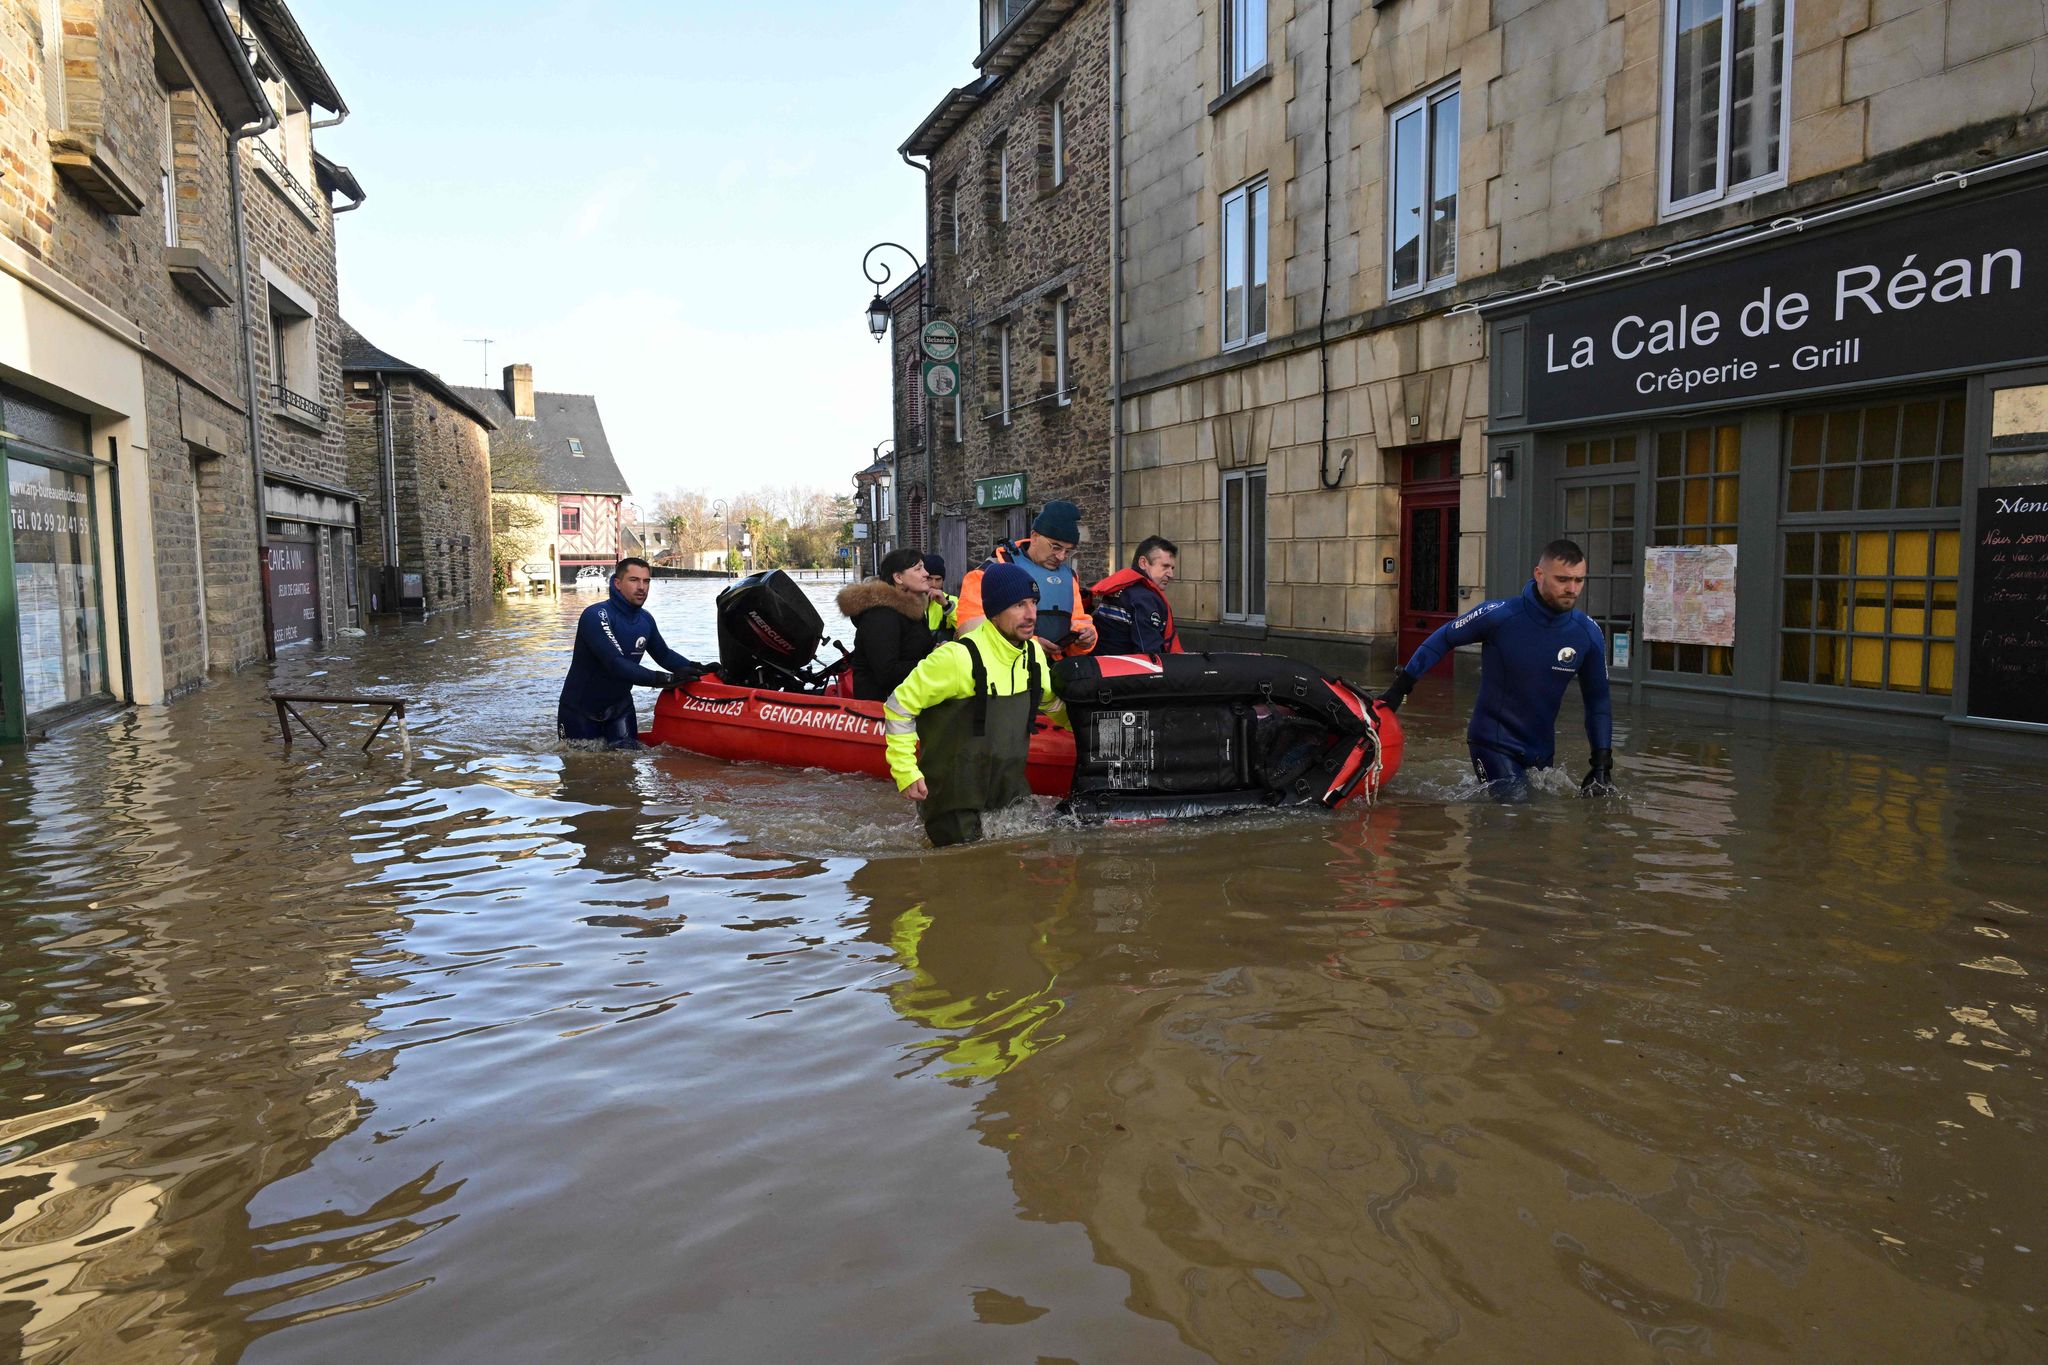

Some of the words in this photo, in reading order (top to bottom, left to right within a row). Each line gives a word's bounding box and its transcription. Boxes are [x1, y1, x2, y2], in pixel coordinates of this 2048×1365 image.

[1547, 333, 1595, 373] La
[1611, 304, 1721, 360] Cale
[1740, 286, 1810, 337] de
[1835, 248, 2022, 321] Réan
[926, 336, 955, 344] Heineken
[1636, 358, 1758, 394] Crêperie
[1791, 338, 1860, 371] Grill
[11, 509, 29, 530] Tél.
[31, 511, 42, 531] 02
[44, 513, 55, 532] 99
[56, 514, 67, 533] 22
[68, 516, 78, 533] 41
[79, 517, 89, 535] 55
[1983, 529, 2011, 545] Nous
[2015, 533, 2048, 544] som
[268, 549, 285, 570] CAVE
[290, 550, 301, 570] VIN
[748, 610, 796, 650] MERCURY
[759, 704, 871, 734] GENDARMERIE
[873, 720, 886, 736] N
